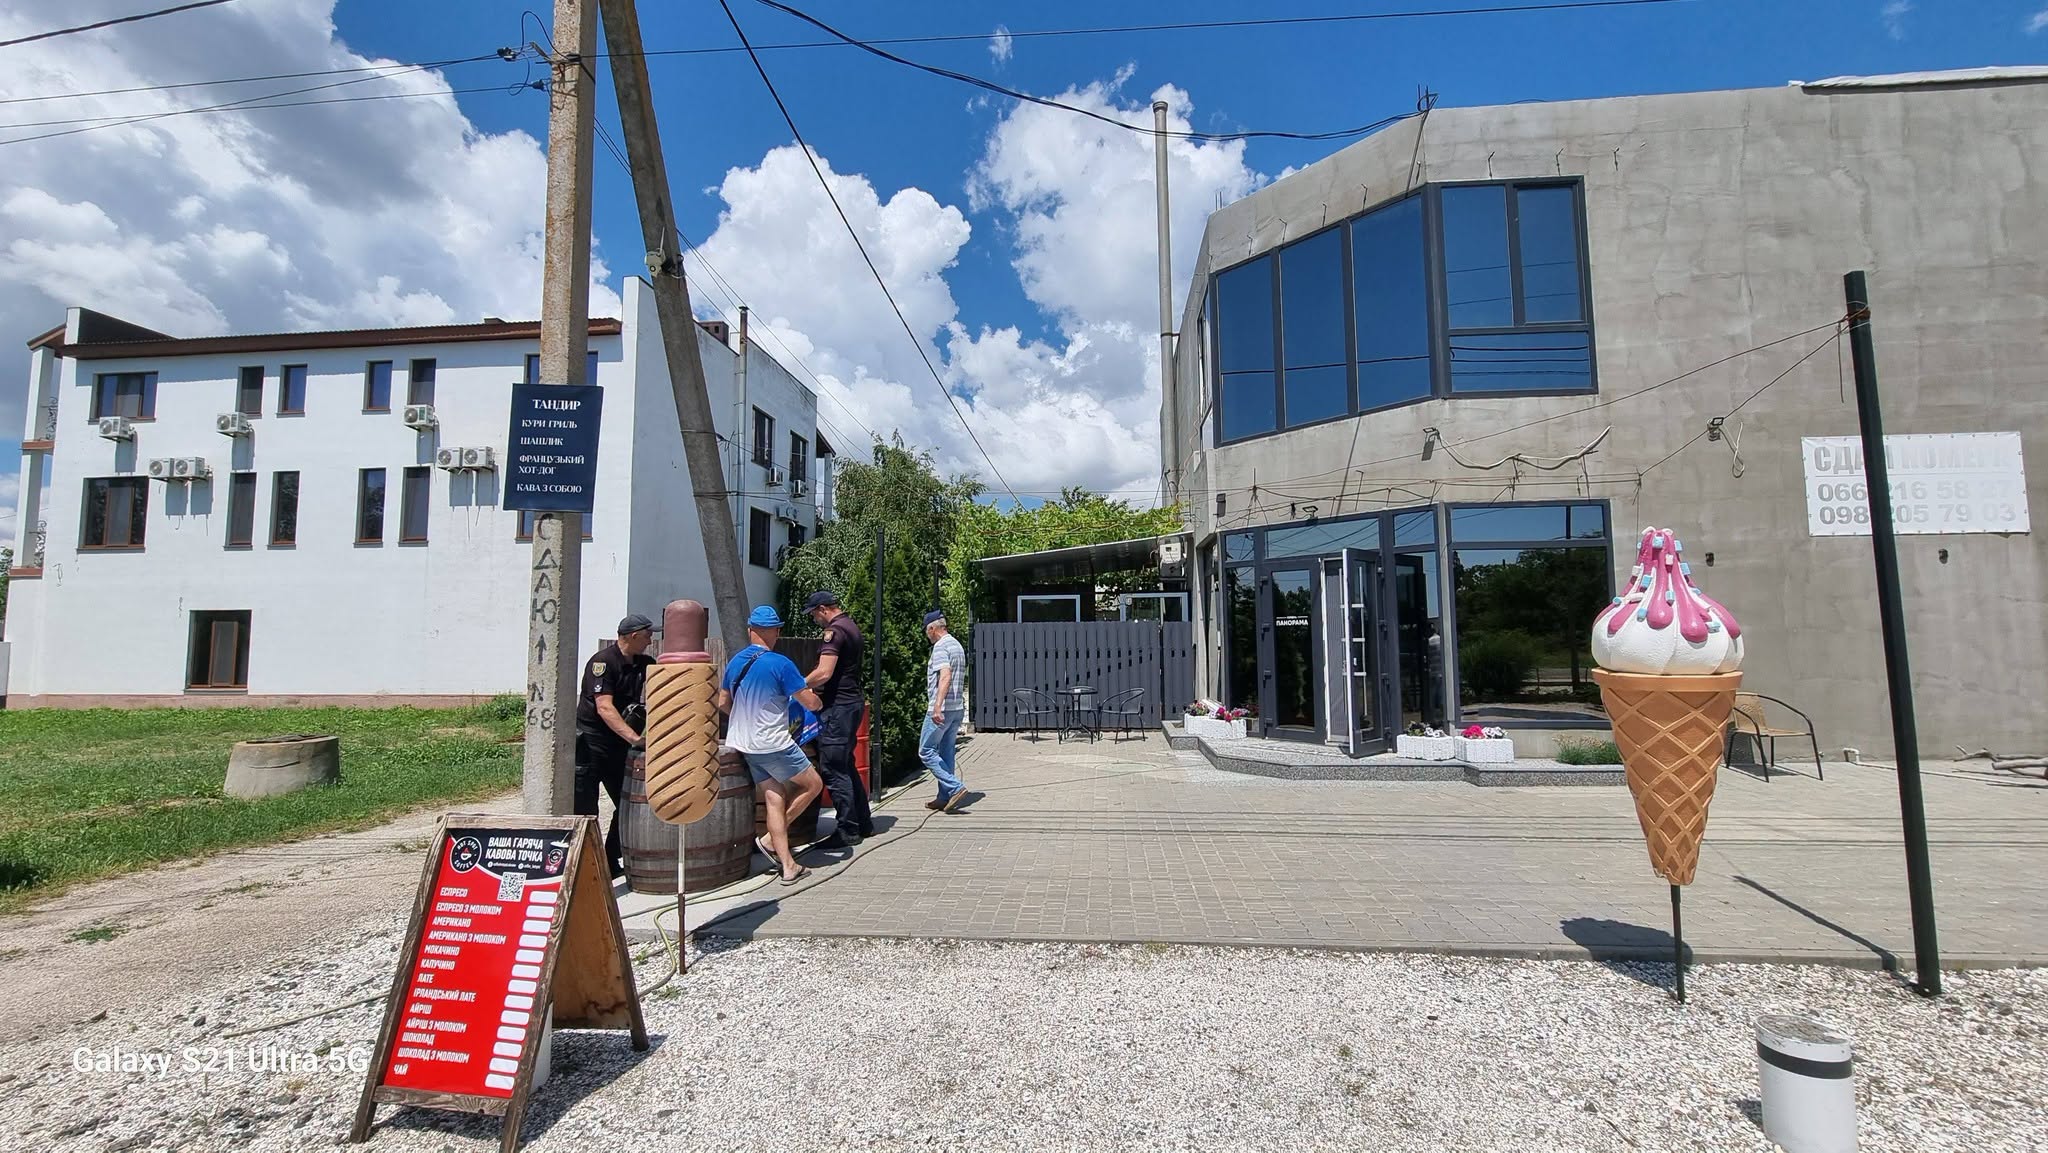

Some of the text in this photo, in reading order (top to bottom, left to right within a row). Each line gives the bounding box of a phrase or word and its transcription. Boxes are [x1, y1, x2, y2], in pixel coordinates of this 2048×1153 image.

[533, 399, 581, 411] ТАНДИР
[522, 419, 577, 429] КУРИ ГРИЛЬ
[520, 437, 563, 446] ШАШЛИК
[519, 455, 584, 464] ФРАНЦУЗЬКИЙ
[518, 465, 556, 475] ХОТ-ДОГ
[517, 483, 541, 492] КАВА
[549, 484, 582, 493] СОБОЮ
[1817, 482, 1868, 502] 066
[1888, 481, 1928, 500] 16
[1819, 503, 2017, 525] 098 05 79 03
[531, 513, 558, 624] СДАЮ
[488, 837, 544, 850] ВАША ГАРЯЧА
[485, 849, 543, 862] КАВОВА ТОЧКА
[440, 886, 468, 897] ЕСПРЕСО
[436, 902, 463, 913] ЕСПРЕСО
[469, 905, 502, 916] МОЛОКОМ
[432, 917, 471, 928] АМЕРИКАНО
[428, 931, 467, 942] АМЕРИКАНО
[473, 934, 506, 945] МОЛОКОМ
[424, 945, 460, 956] МОКАЧИНО
[420, 959, 455, 970] КАПУЧИНО
[417, 973, 434, 984] ЛАТЕ
[413, 988, 476, 1002] ІРЛАНДСЬКИЙ ЛАТЕ
[410, 1003, 432, 1014] АЙРІШ
[406, 1018, 428, 1030] АЙРІШ
[433, 1021, 467, 1033] МОЛОКОМ
[402, 1032, 435, 1045] ШОКОЛАД
[398, 1048, 430, 1061] ШОКОЛАД
[436, 1052, 469, 1063] МОЛОКОМ
[394, 1063, 408, 1075] ЧАЙ
